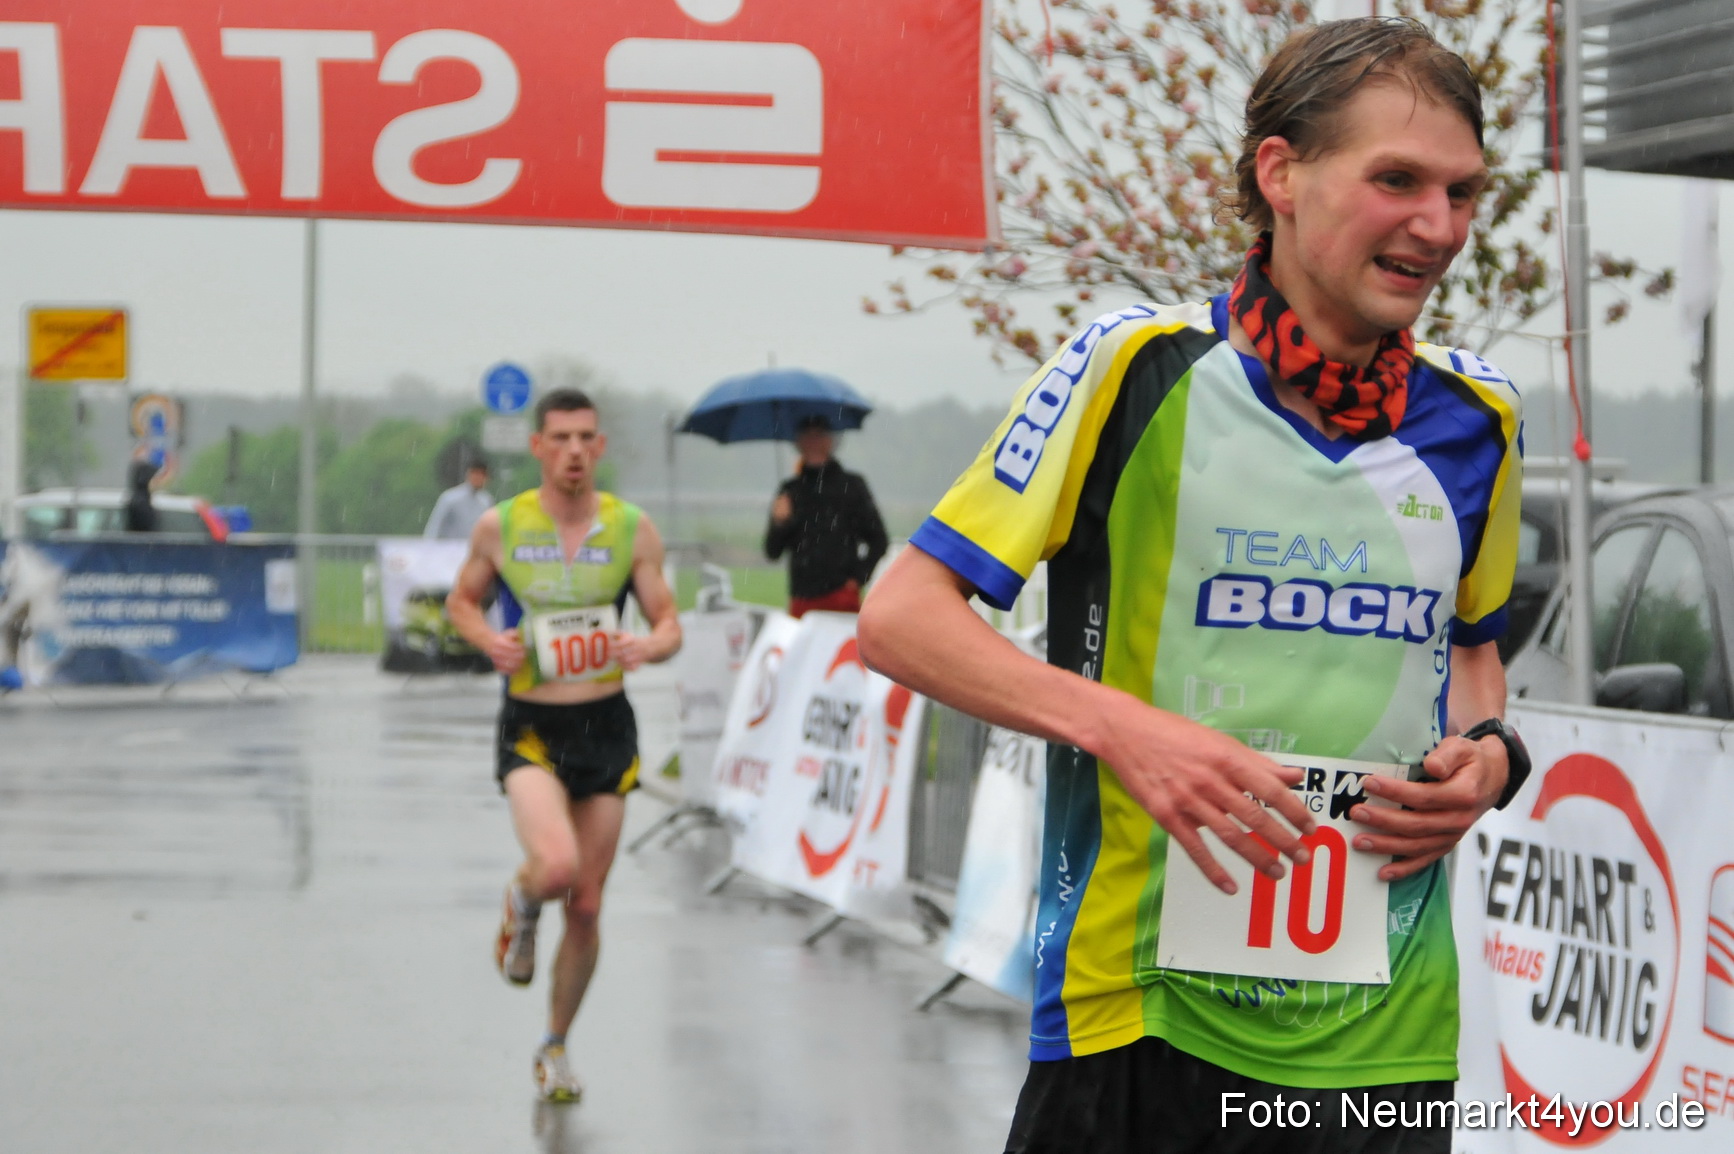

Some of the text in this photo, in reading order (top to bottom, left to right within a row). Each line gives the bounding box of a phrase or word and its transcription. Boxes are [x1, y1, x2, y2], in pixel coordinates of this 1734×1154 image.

[512, 544, 612, 565] BOK
[1216, 527, 1369, 573] TEAM
[1194, 573, 1442, 644] BOCK
[550, 630, 609, 677] 100
[1246, 825, 1348, 954] 10
[1530, 942, 1659, 1053] JÄNIG
